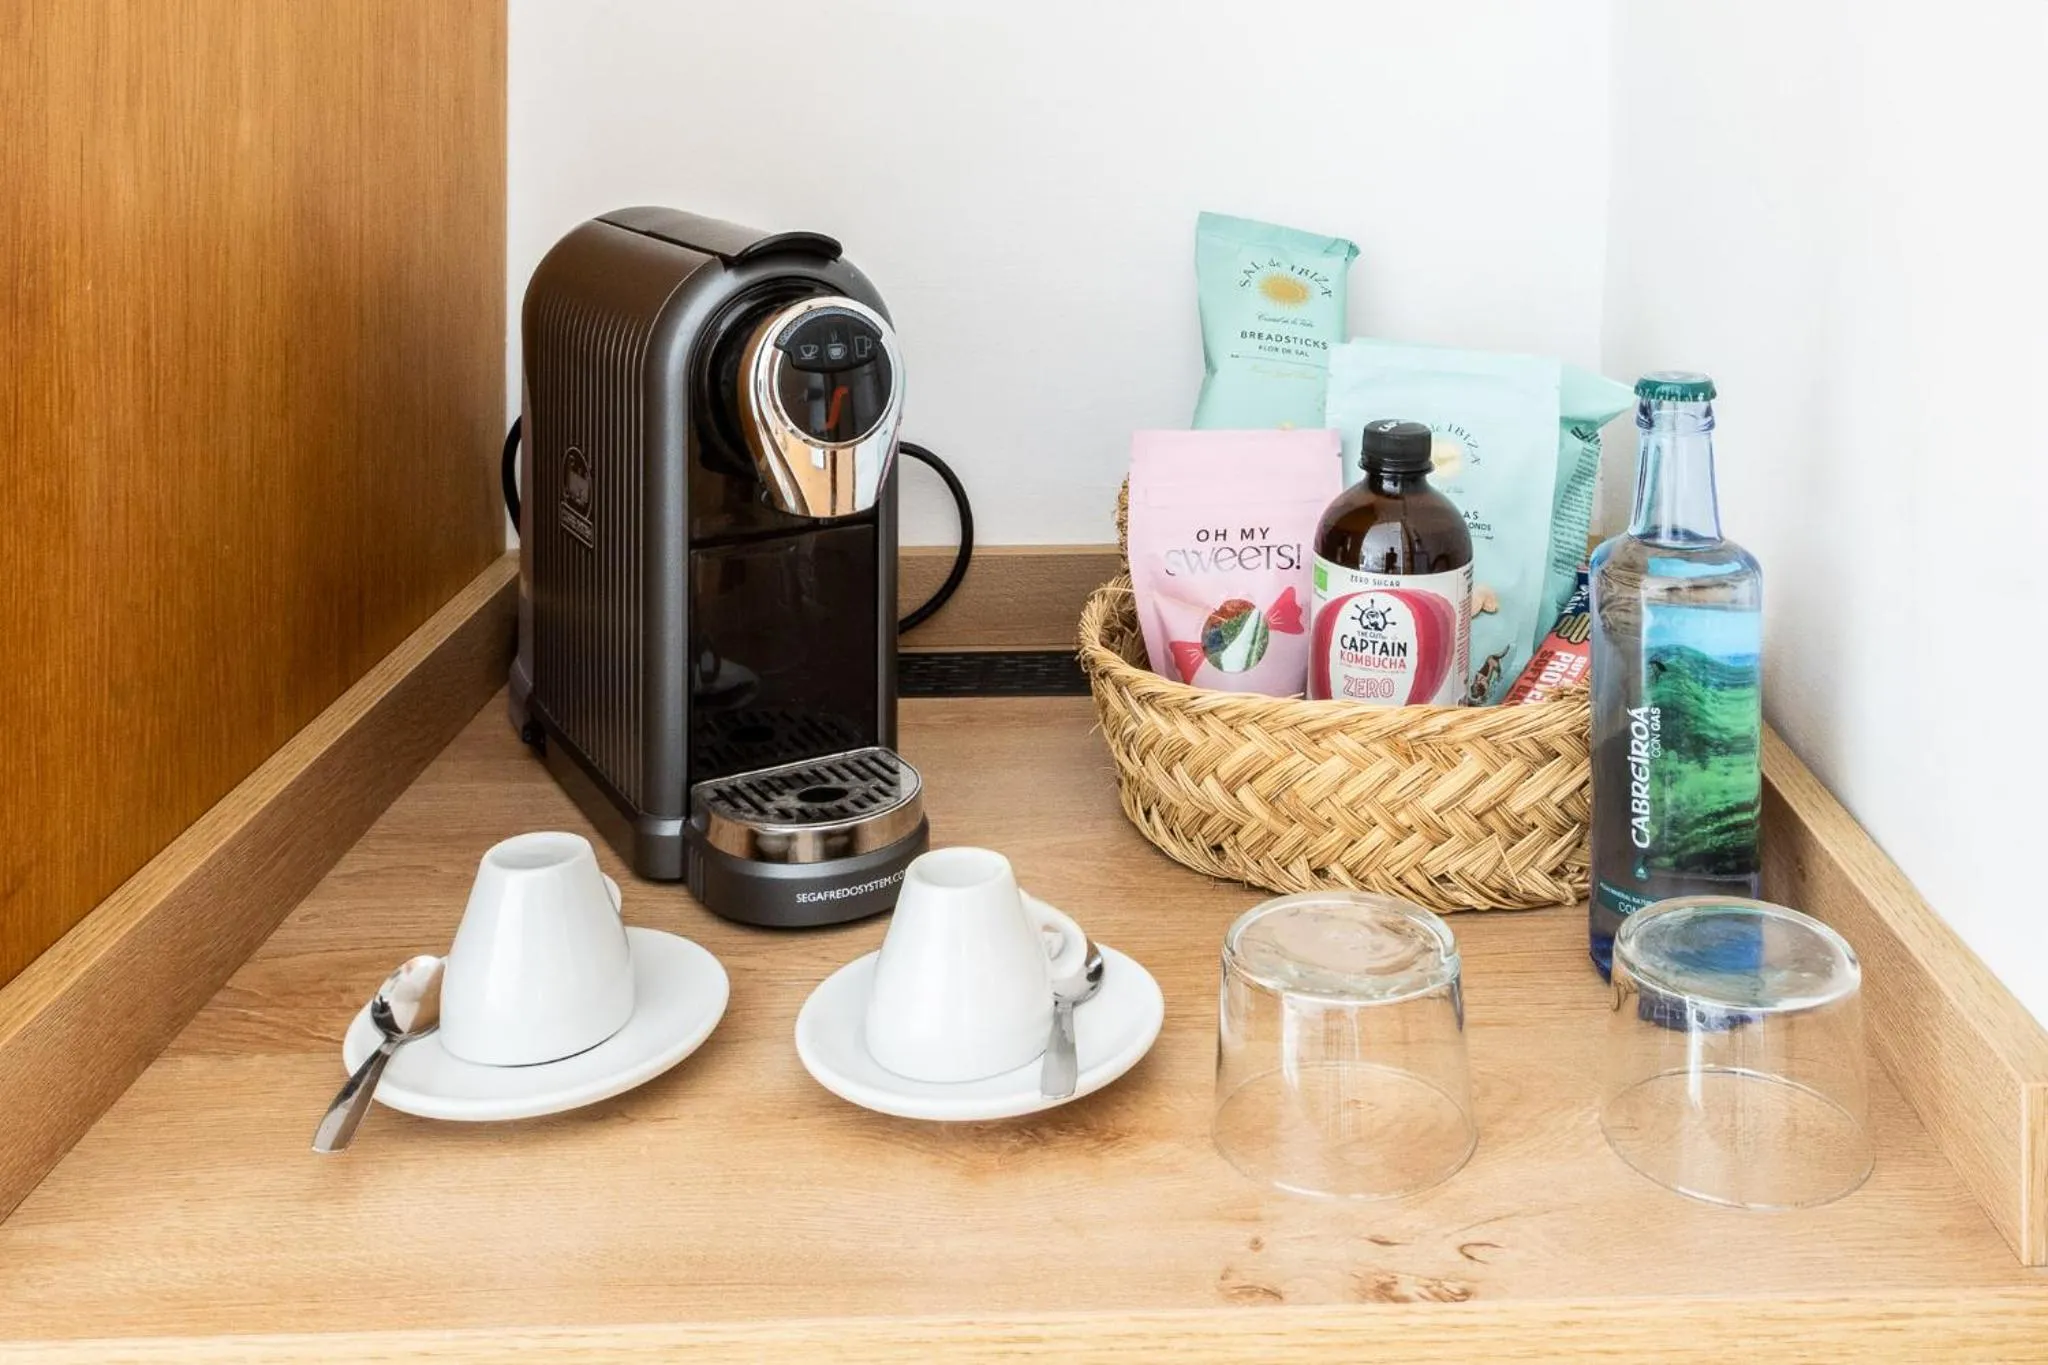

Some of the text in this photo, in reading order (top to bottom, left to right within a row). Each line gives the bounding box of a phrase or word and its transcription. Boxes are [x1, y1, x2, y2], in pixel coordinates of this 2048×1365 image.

[1240, 330, 1329, 350] BREADSTICKS
[1196, 527, 1270, 543] OH MY
[1467, 522, 1492, 532] ONDS
[1350, 574, 1401, 587] ZERO SUGAR
[1340, 634, 1407, 657] CAPTAIN
[1340, 650, 1407, 670] KOMBUCHA
[1343, 674, 1395, 698] ZERO
[1651, 707, 1661, 758] CON GAS
[1626, 706, 1650, 849] CABREIROÁ
[795, 869, 906, 903] SEGAFREDOSYSTEM.CO
